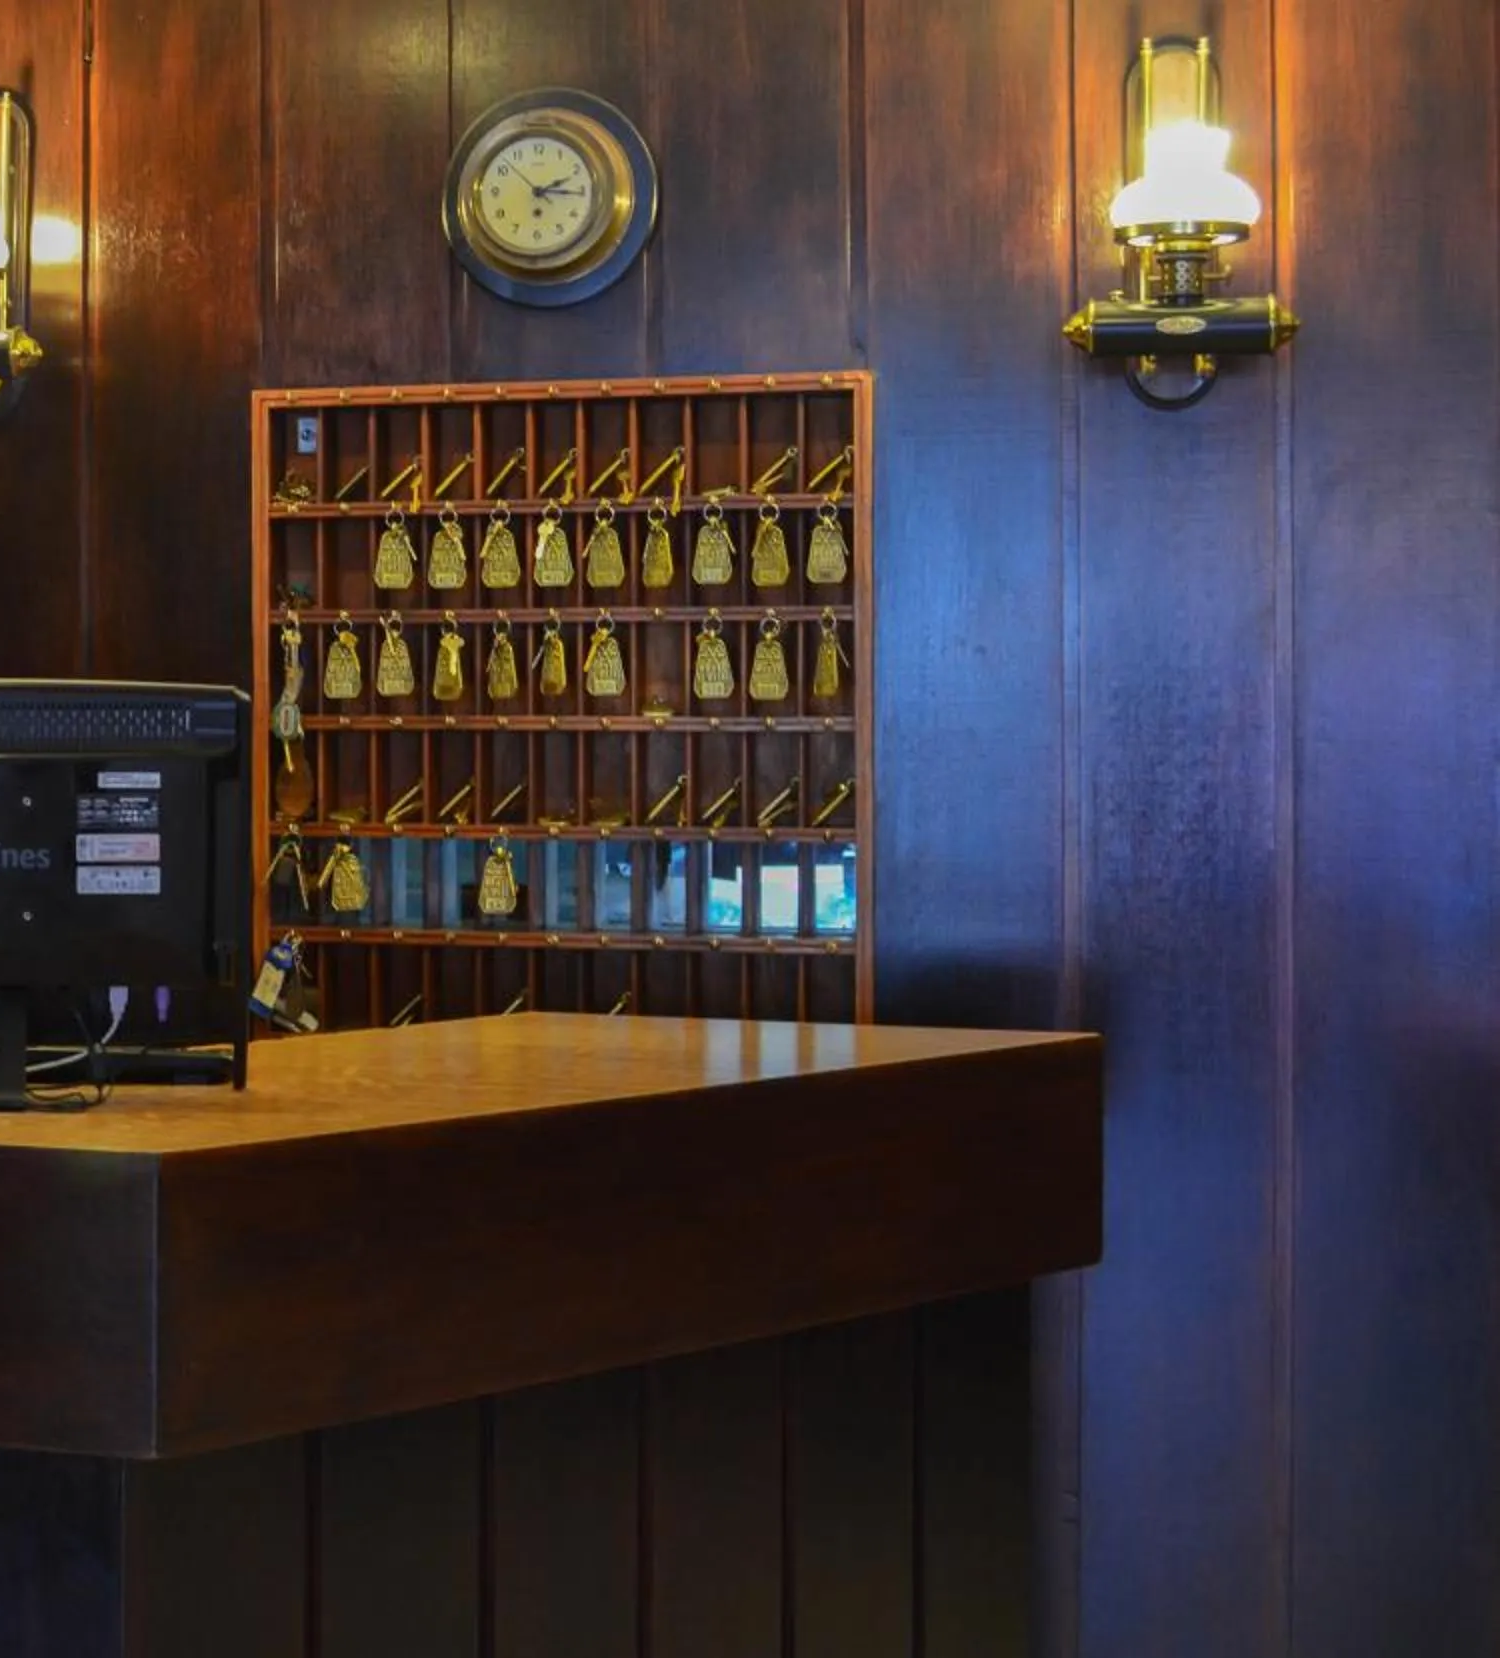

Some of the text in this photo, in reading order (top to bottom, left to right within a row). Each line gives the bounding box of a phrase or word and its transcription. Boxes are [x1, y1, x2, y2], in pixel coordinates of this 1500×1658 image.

[512, 149, 523, 161] 11
[533, 143, 546, 156] 12
[497, 164, 509, 177] 10
[573, 163, 581, 176] 2
[490, 185, 500, 198] 9
[511, 223, 520, 235] 7
[533, 229, 543, 242] 6
[554, 223, 565, 236] 5
